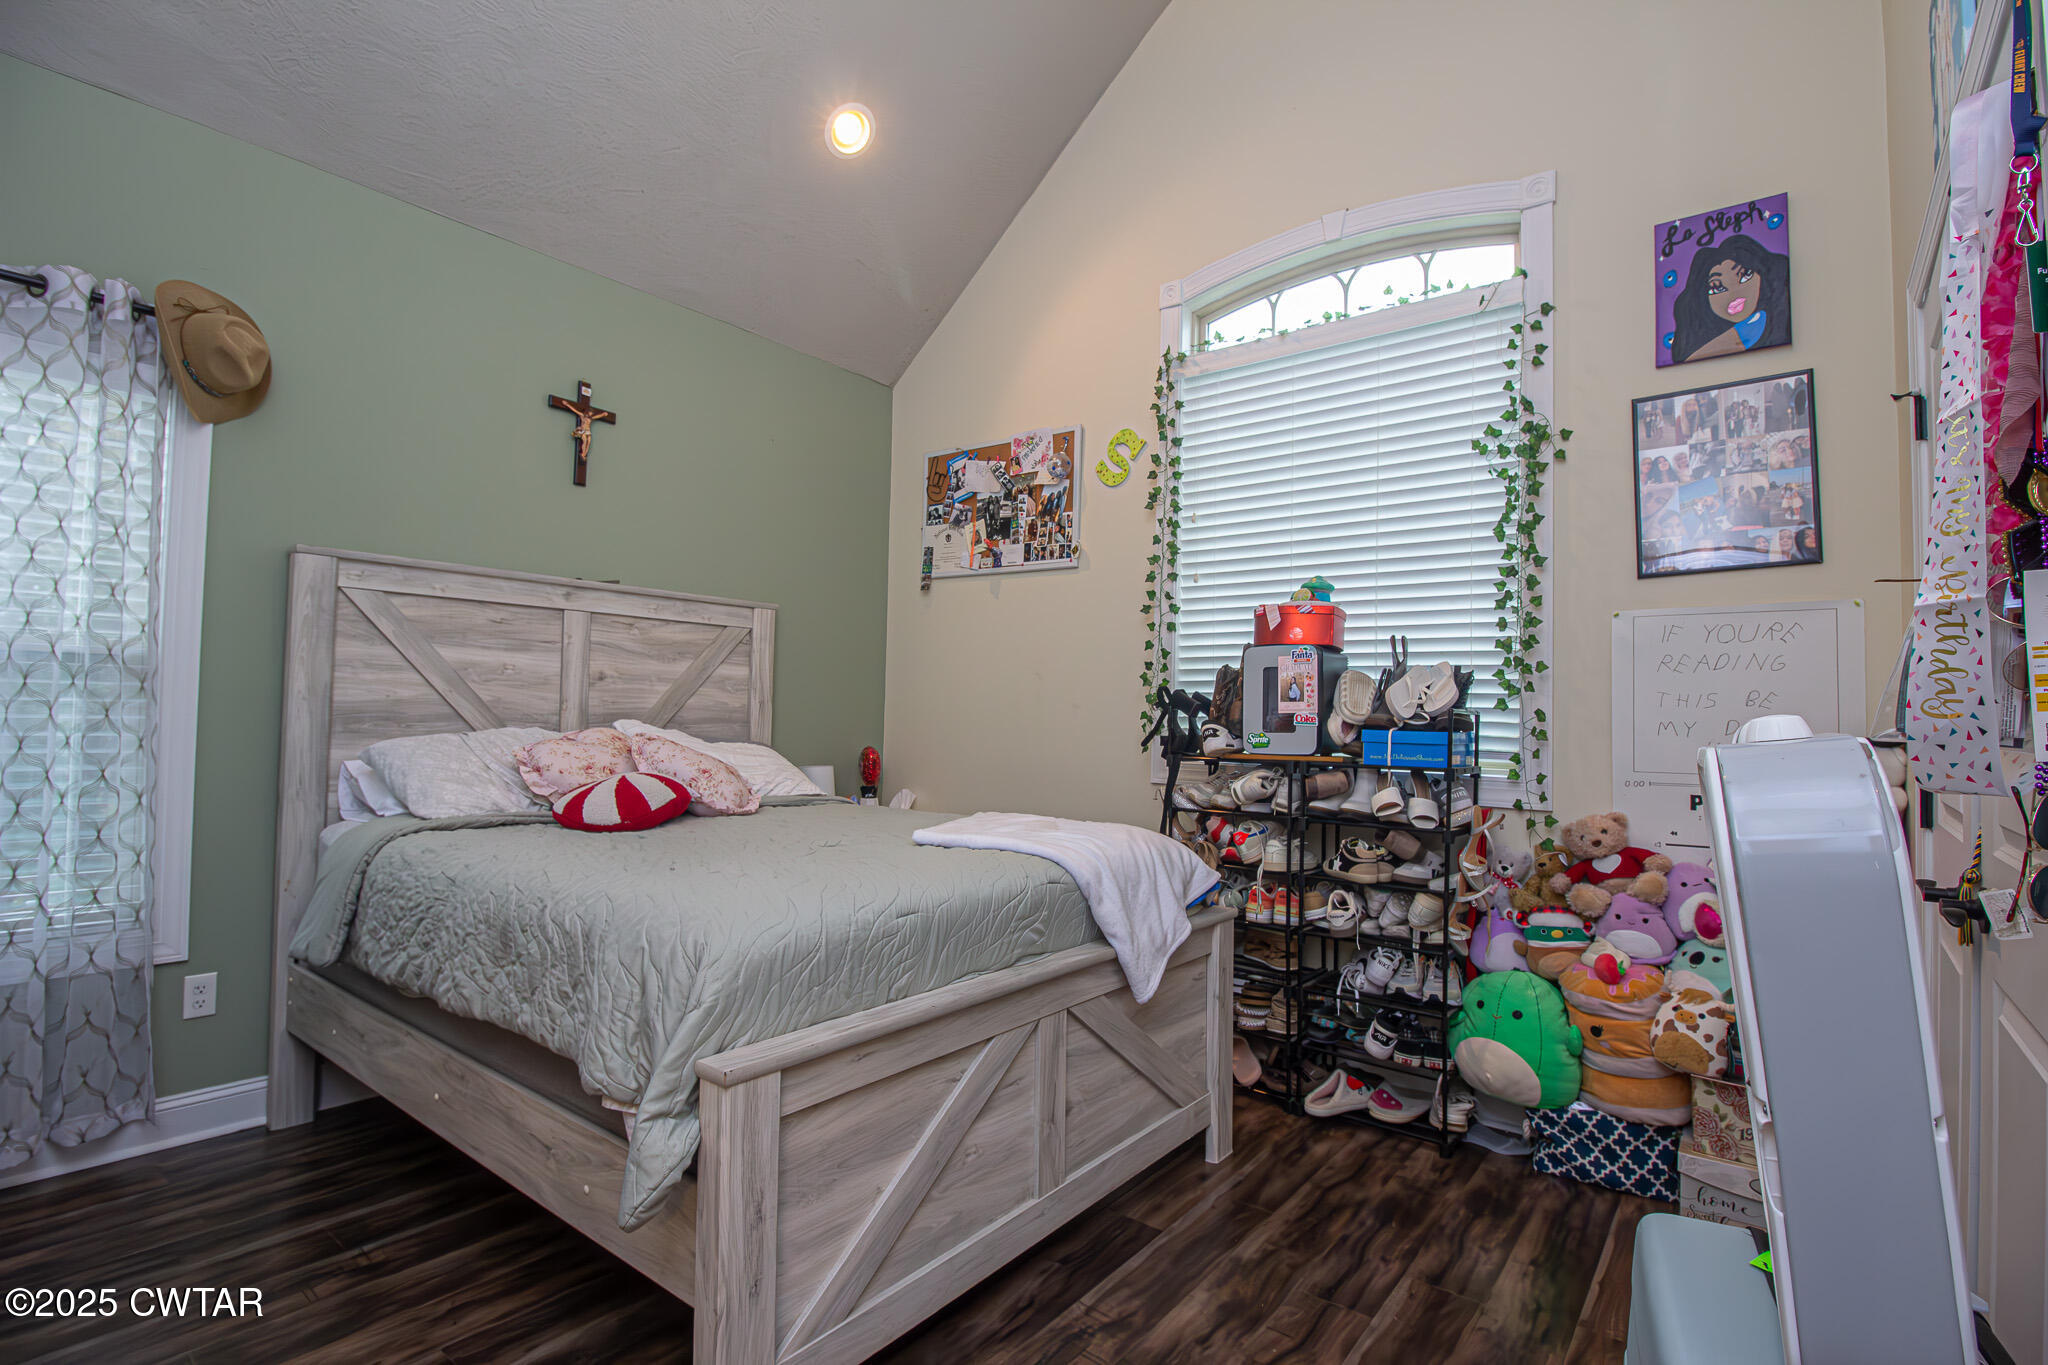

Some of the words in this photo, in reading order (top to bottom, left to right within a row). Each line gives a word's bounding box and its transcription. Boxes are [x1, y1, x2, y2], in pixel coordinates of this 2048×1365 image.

[2013, 73, 2026, 93] CREW
[1696, 200, 1764, 246] Steph
[1939, 475, 1972, 542] My
[1661, 624, 1684, 643] IF
[1918, 551, 1971, 729] Birthday
[1291, 650, 1313, 659] Fanta
[1656, 653, 1787, 674] READING
[1656, 691, 1718, 709] THIS
[1744, 690, 1779, 710] BE
[1295, 714, 1316, 722] Coke
[1248, 733, 1269, 744] Sprite
[1657, 720, 1697, 738] MY
[1689, 794, 1704, 811] P
[1697, 1186, 1763, 1217] home
